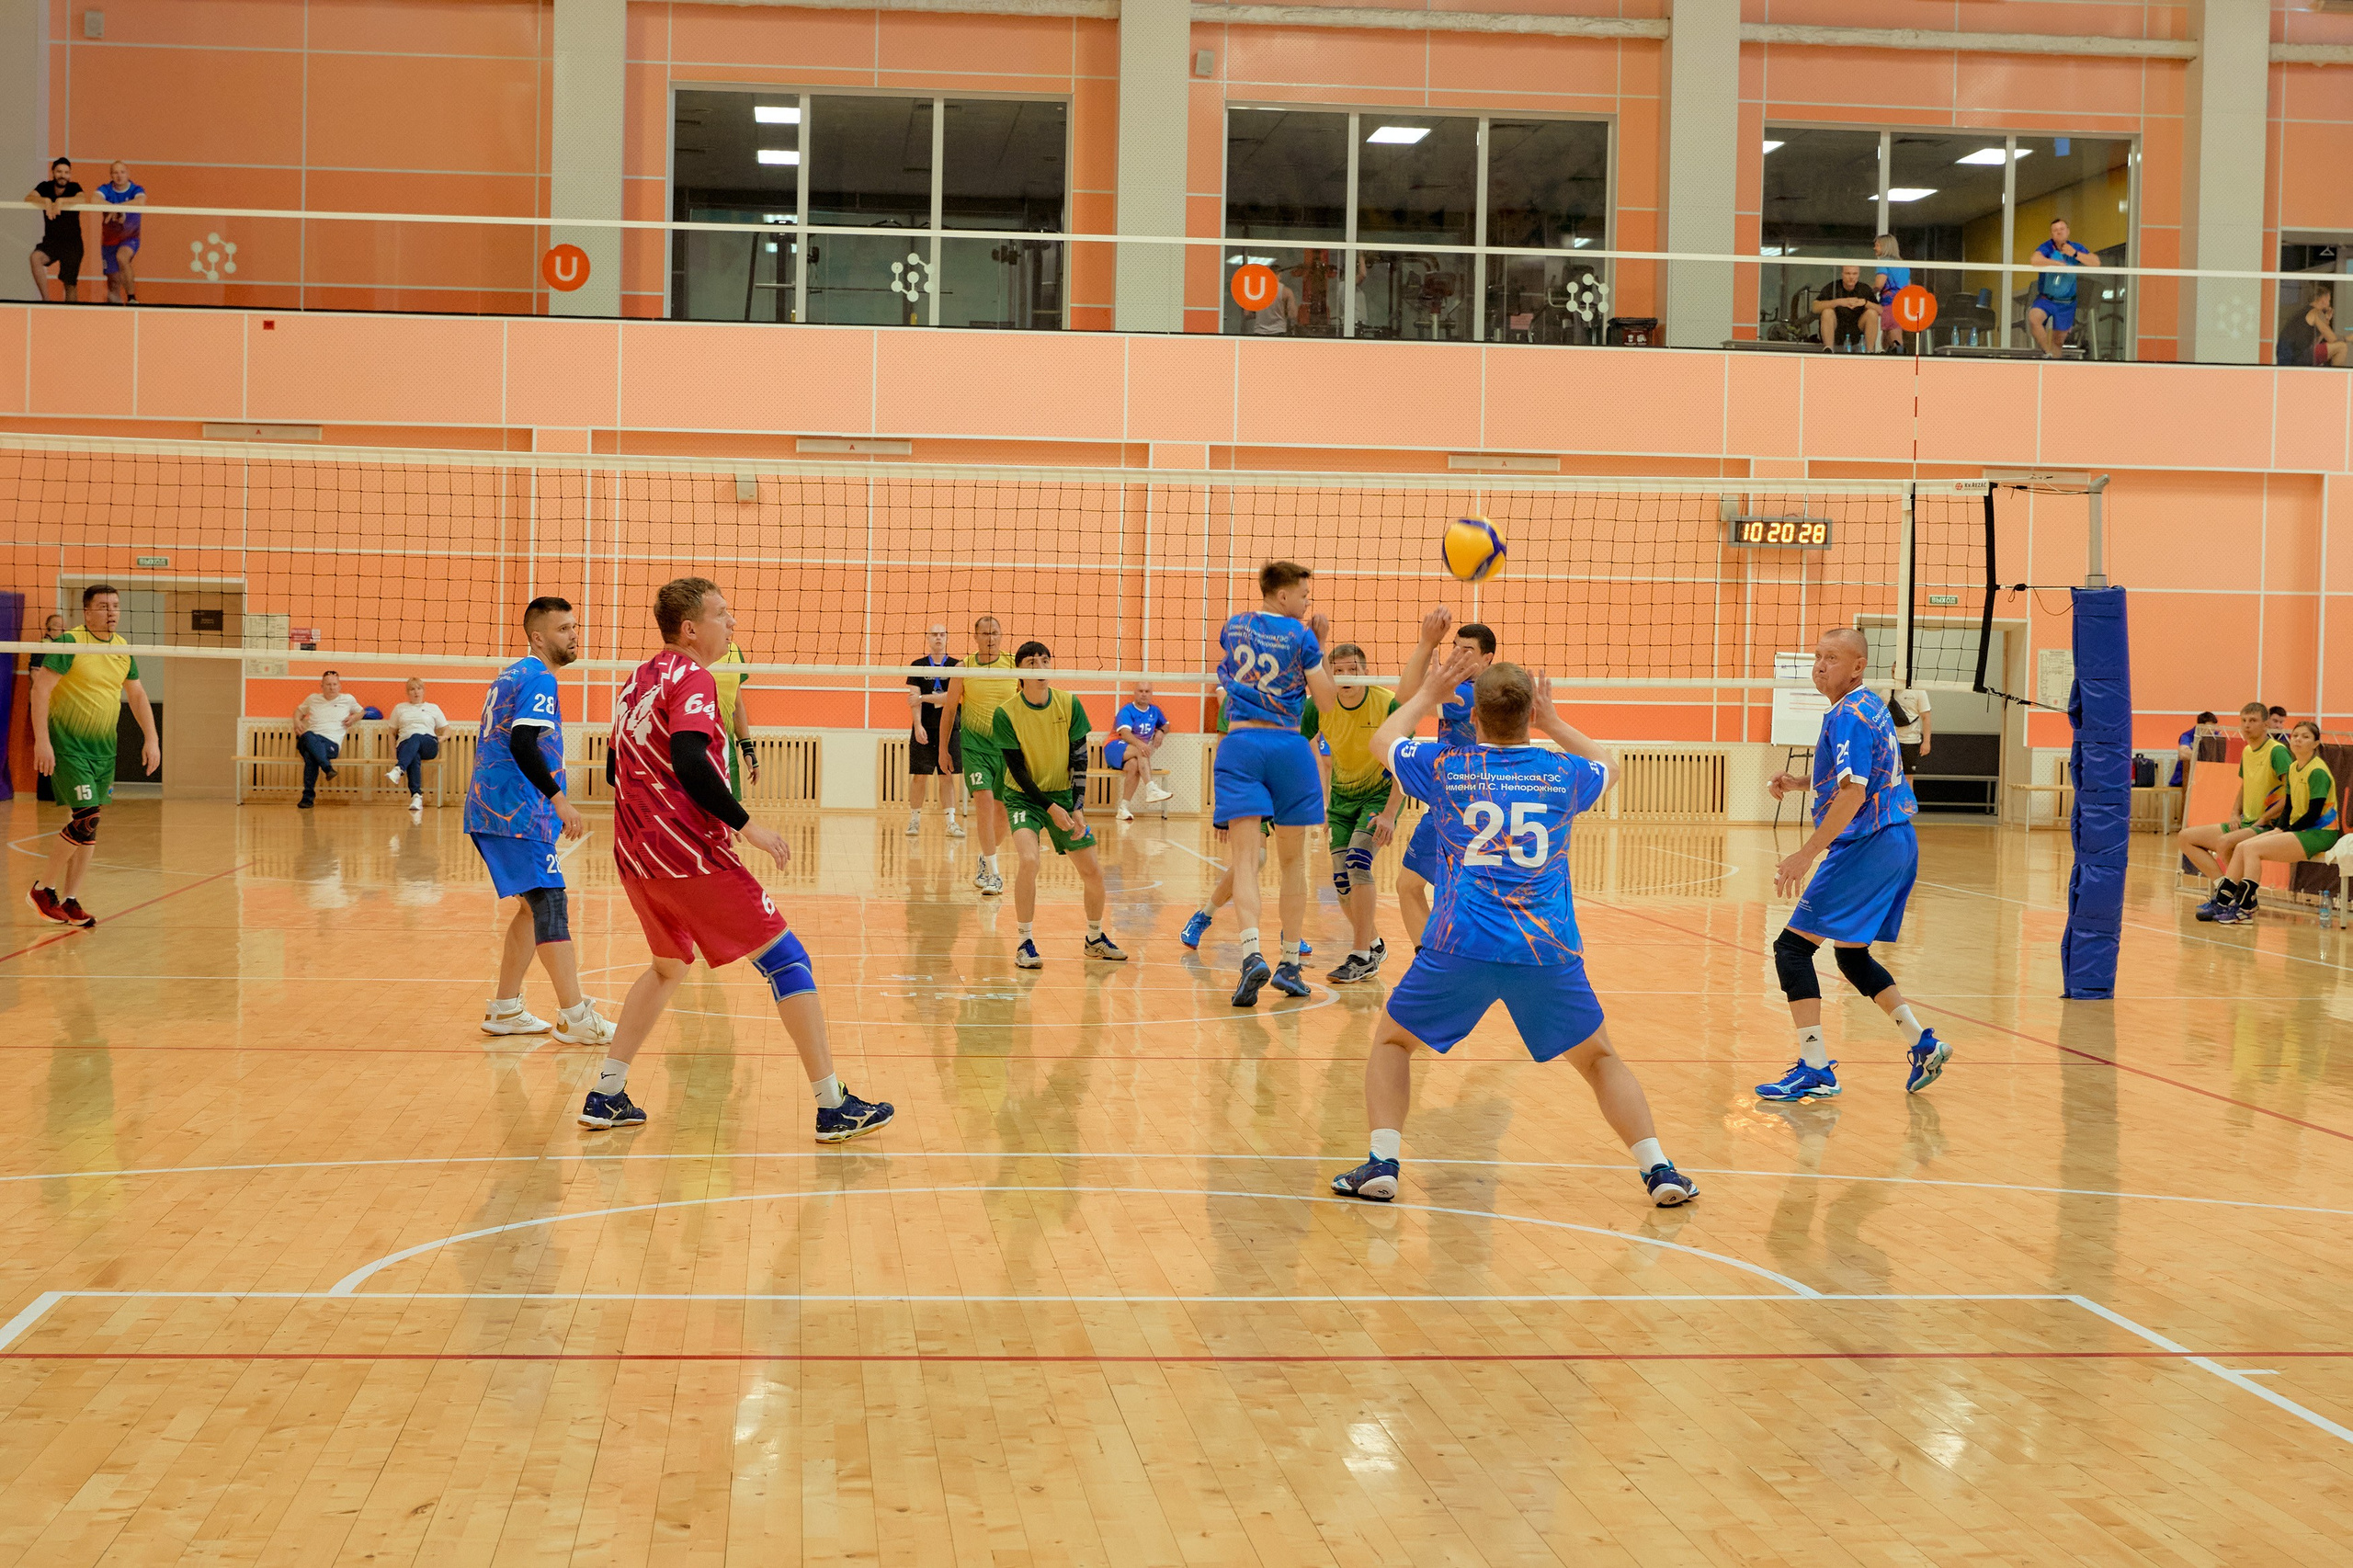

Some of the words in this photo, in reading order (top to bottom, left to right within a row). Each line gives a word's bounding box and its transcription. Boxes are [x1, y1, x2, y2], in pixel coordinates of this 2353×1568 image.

[555, 256, 578, 281] U
[1244, 276, 1266, 301] U
[1904, 297, 1926, 321] U
[1743, 522, 1764, 542] 10
[1767, 522, 1795, 543] 20
[1798, 523, 1826, 544] 28
[1233, 643, 1282, 697] 22
[532, 693, 555, 715] 28
[684, 693, 715, 721] 64
[1139, 722, 1152, 734] 15
[1836, 739, 1850, 766] 24
[969, 771, 983, 786] 12
[1445, 783, 1476, 791] имени
[1501, 783, 1567, 793] Непорожнего
[1447, 772, 1541, 781] Саяно-Шушенская
[1543, 774, 1562, 782] ГЭС
[74, 784, 92, 801] 15
[1013, 811, 1027, 824] 11
[1462, 801, 1549, 869] 25
